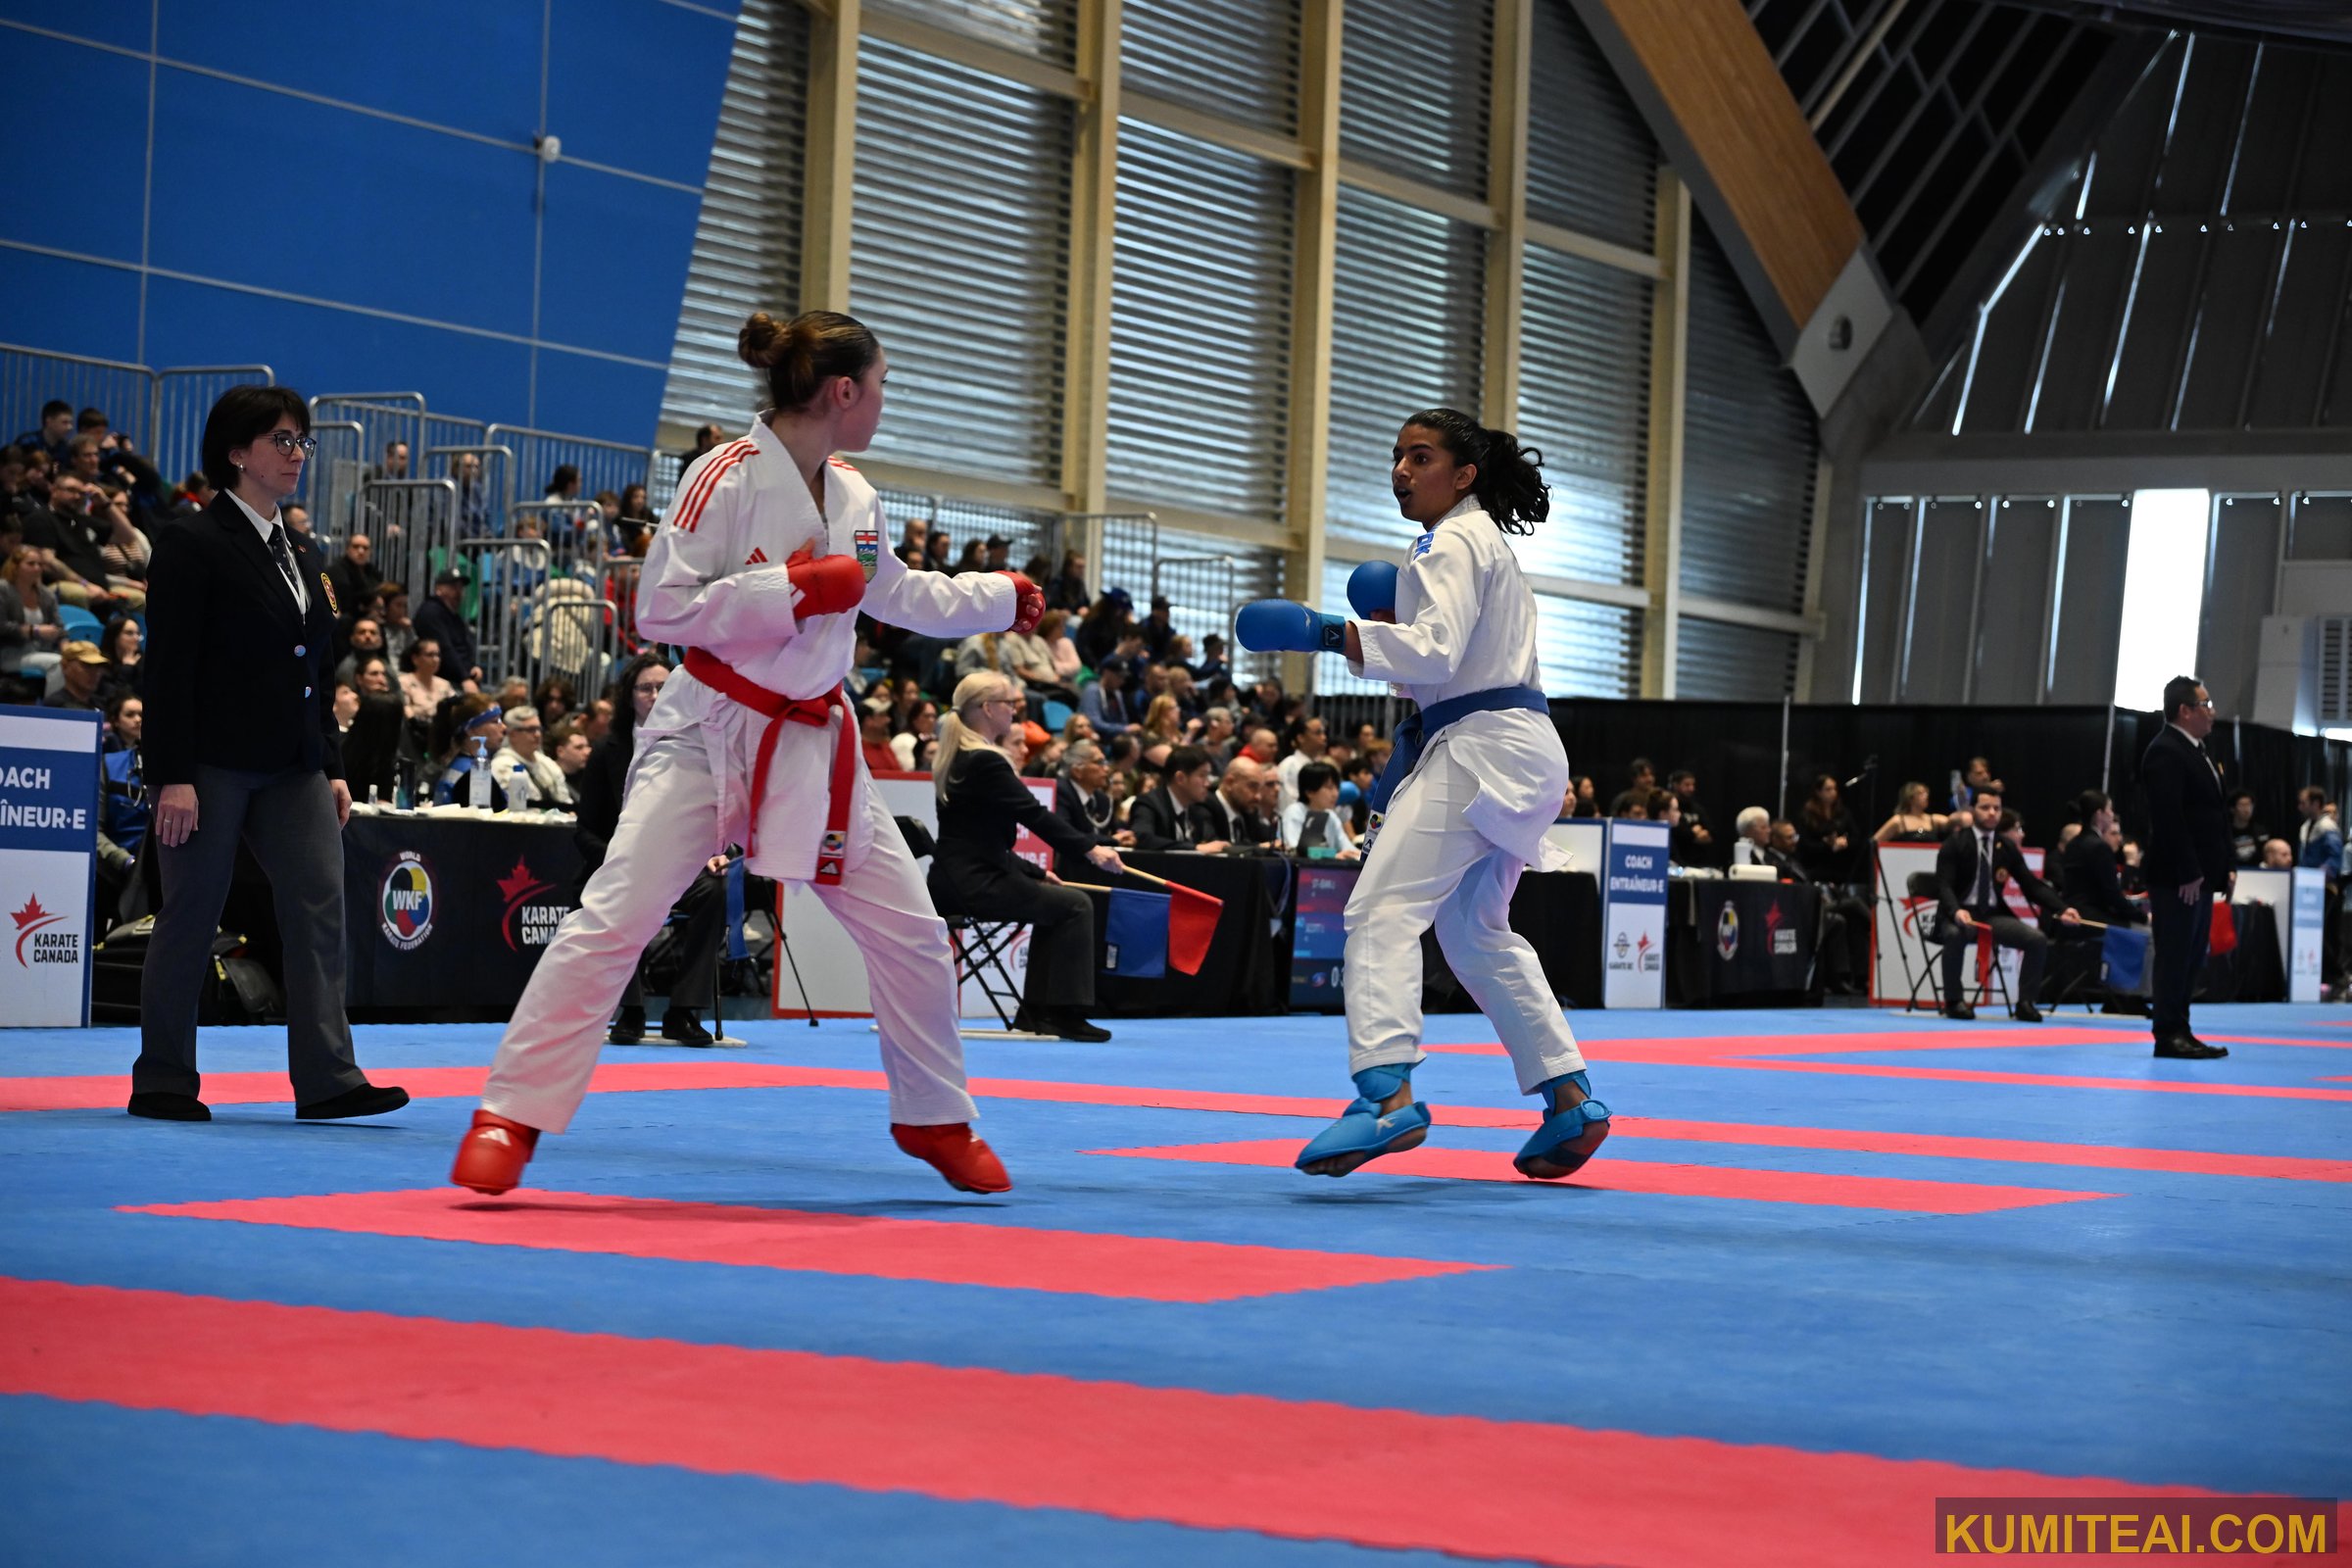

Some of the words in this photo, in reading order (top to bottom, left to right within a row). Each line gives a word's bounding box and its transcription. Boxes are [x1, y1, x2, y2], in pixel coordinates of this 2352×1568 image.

[1625, 855, 1652, 869] COACH
[392, 890, 422, 910] WKF
[34, 933, 78, 949] KARATE
[33, 949, 78, 963] CANADA
